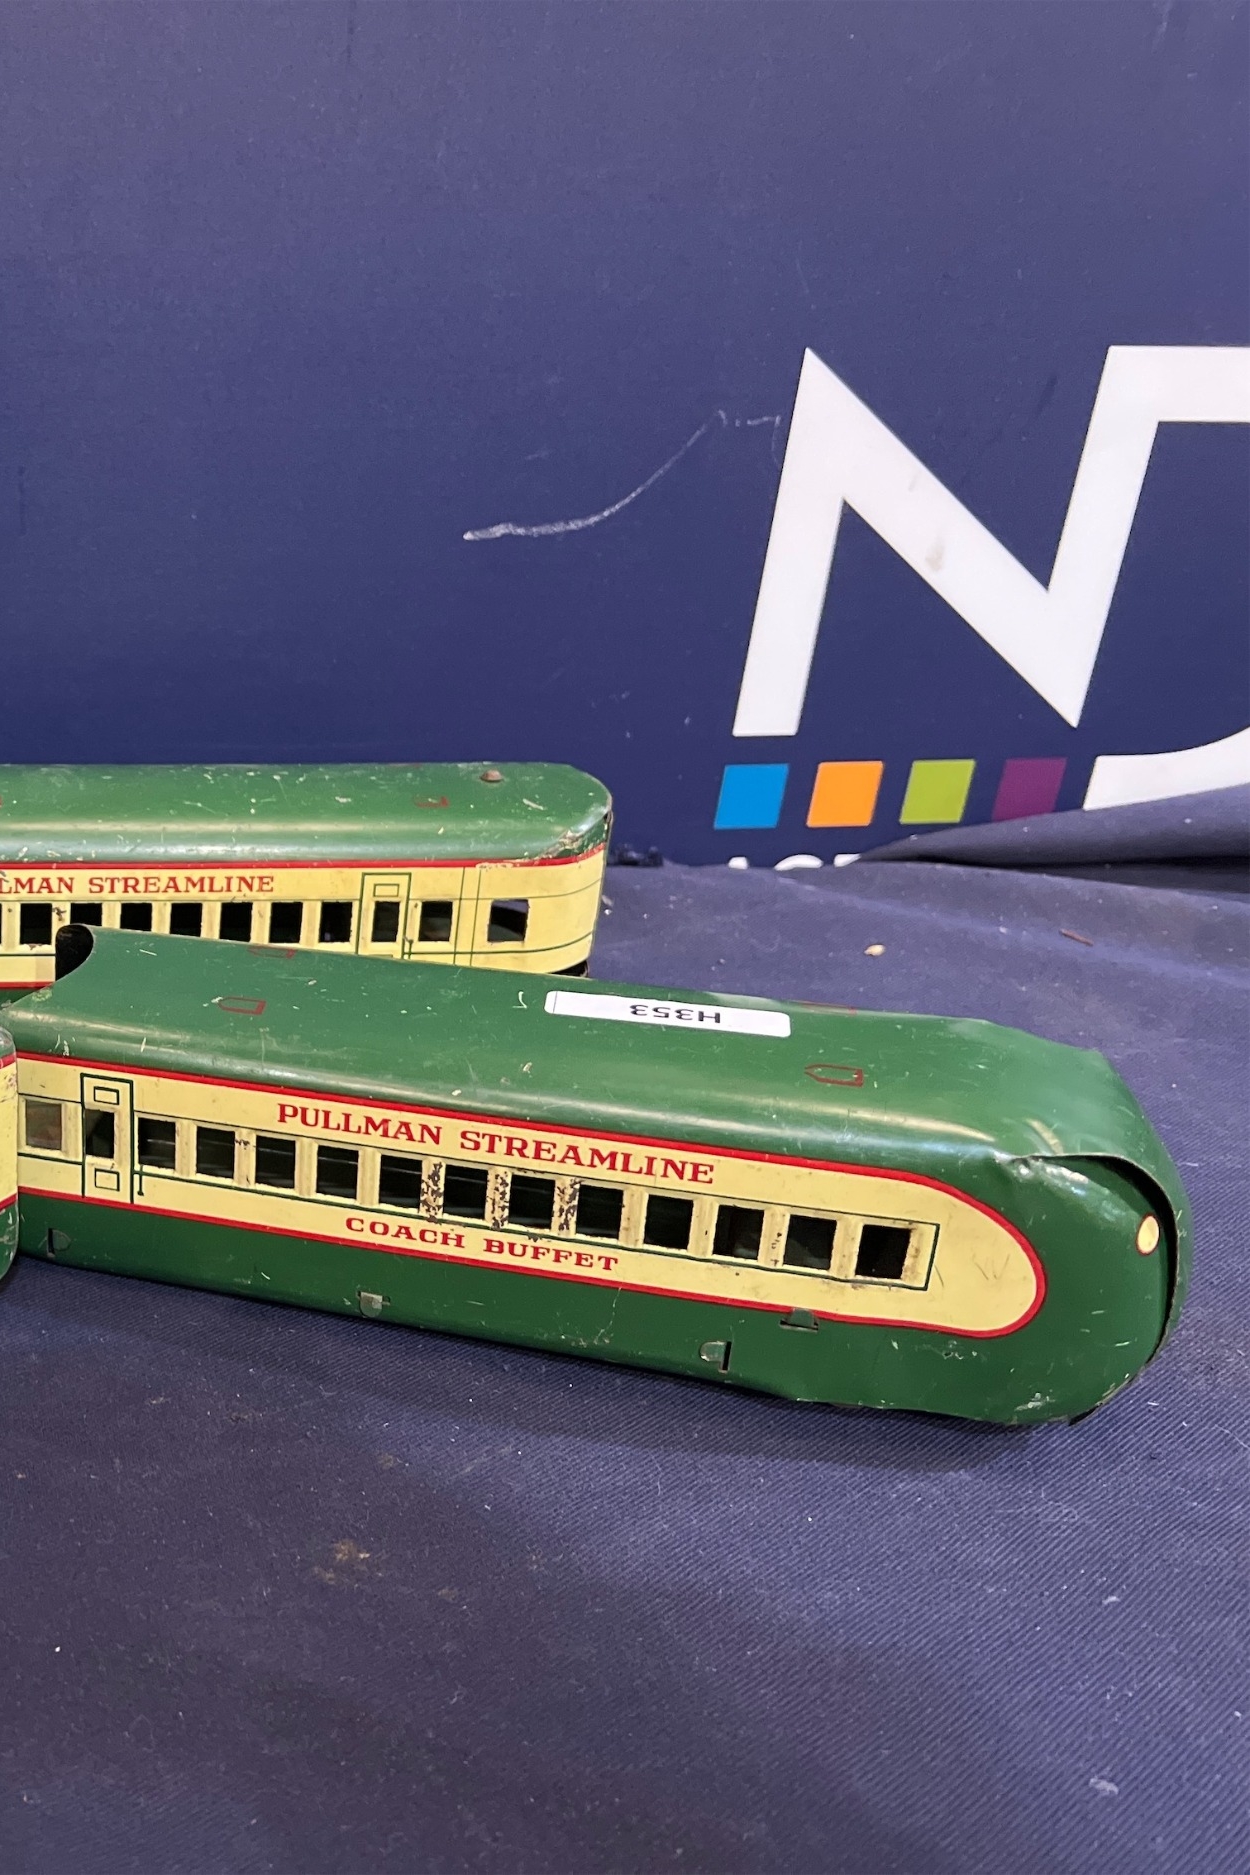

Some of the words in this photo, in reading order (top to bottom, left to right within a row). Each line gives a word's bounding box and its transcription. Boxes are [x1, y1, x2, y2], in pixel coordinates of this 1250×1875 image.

[88, 875, 274, 894] STREAMLINE
[629, 1004, 721, 1024] H353
[277, 1103, 442, 1146] PULLMAN
[460, 1130, 715, 1185] STREAMLINE
[345, 1217, 465, 1249] COACH
[483, 1238, 618, 1272] BUFFET
